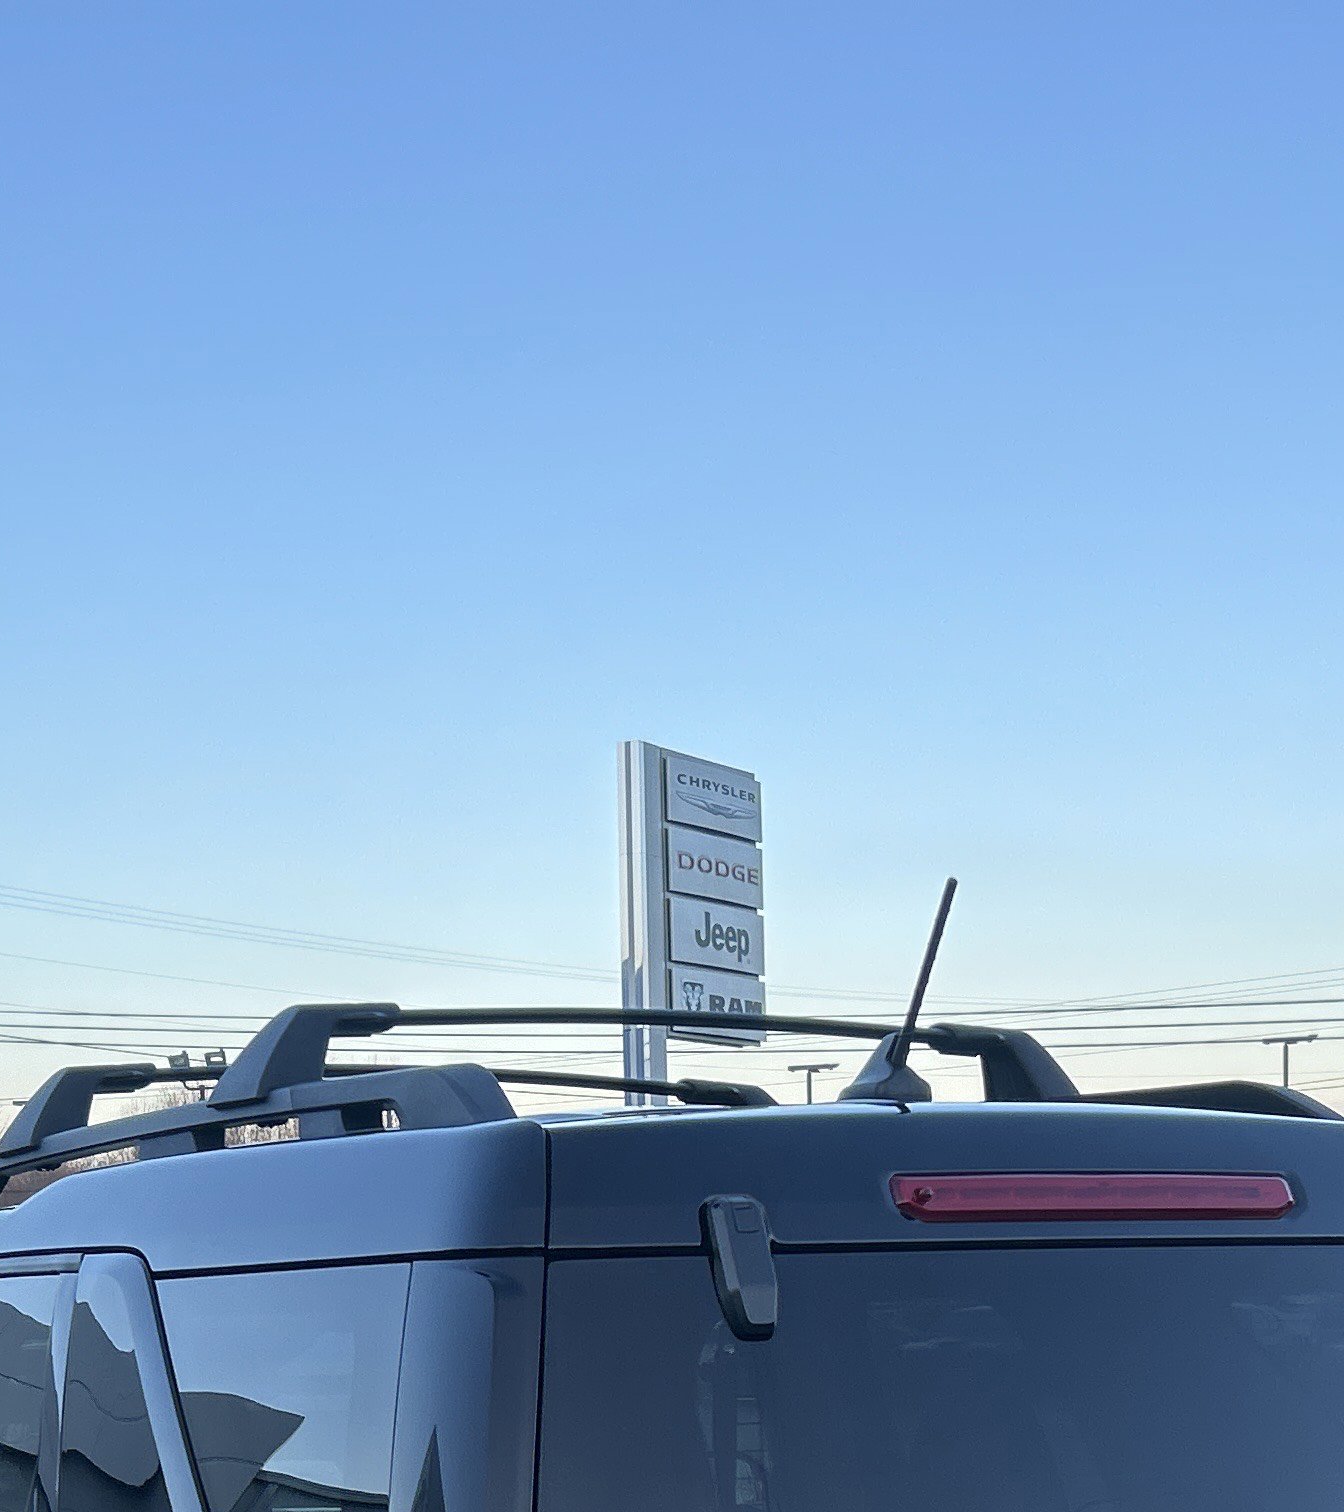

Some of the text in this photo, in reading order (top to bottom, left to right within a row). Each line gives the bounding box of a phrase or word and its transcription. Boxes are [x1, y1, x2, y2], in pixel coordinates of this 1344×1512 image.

[676, 773, 756, 804] CHRYSLER
[677, 850, 759, 887] DODGE
[694, 911, 750, 964] Jeep
[709, 994, 763, 1014] RAM
